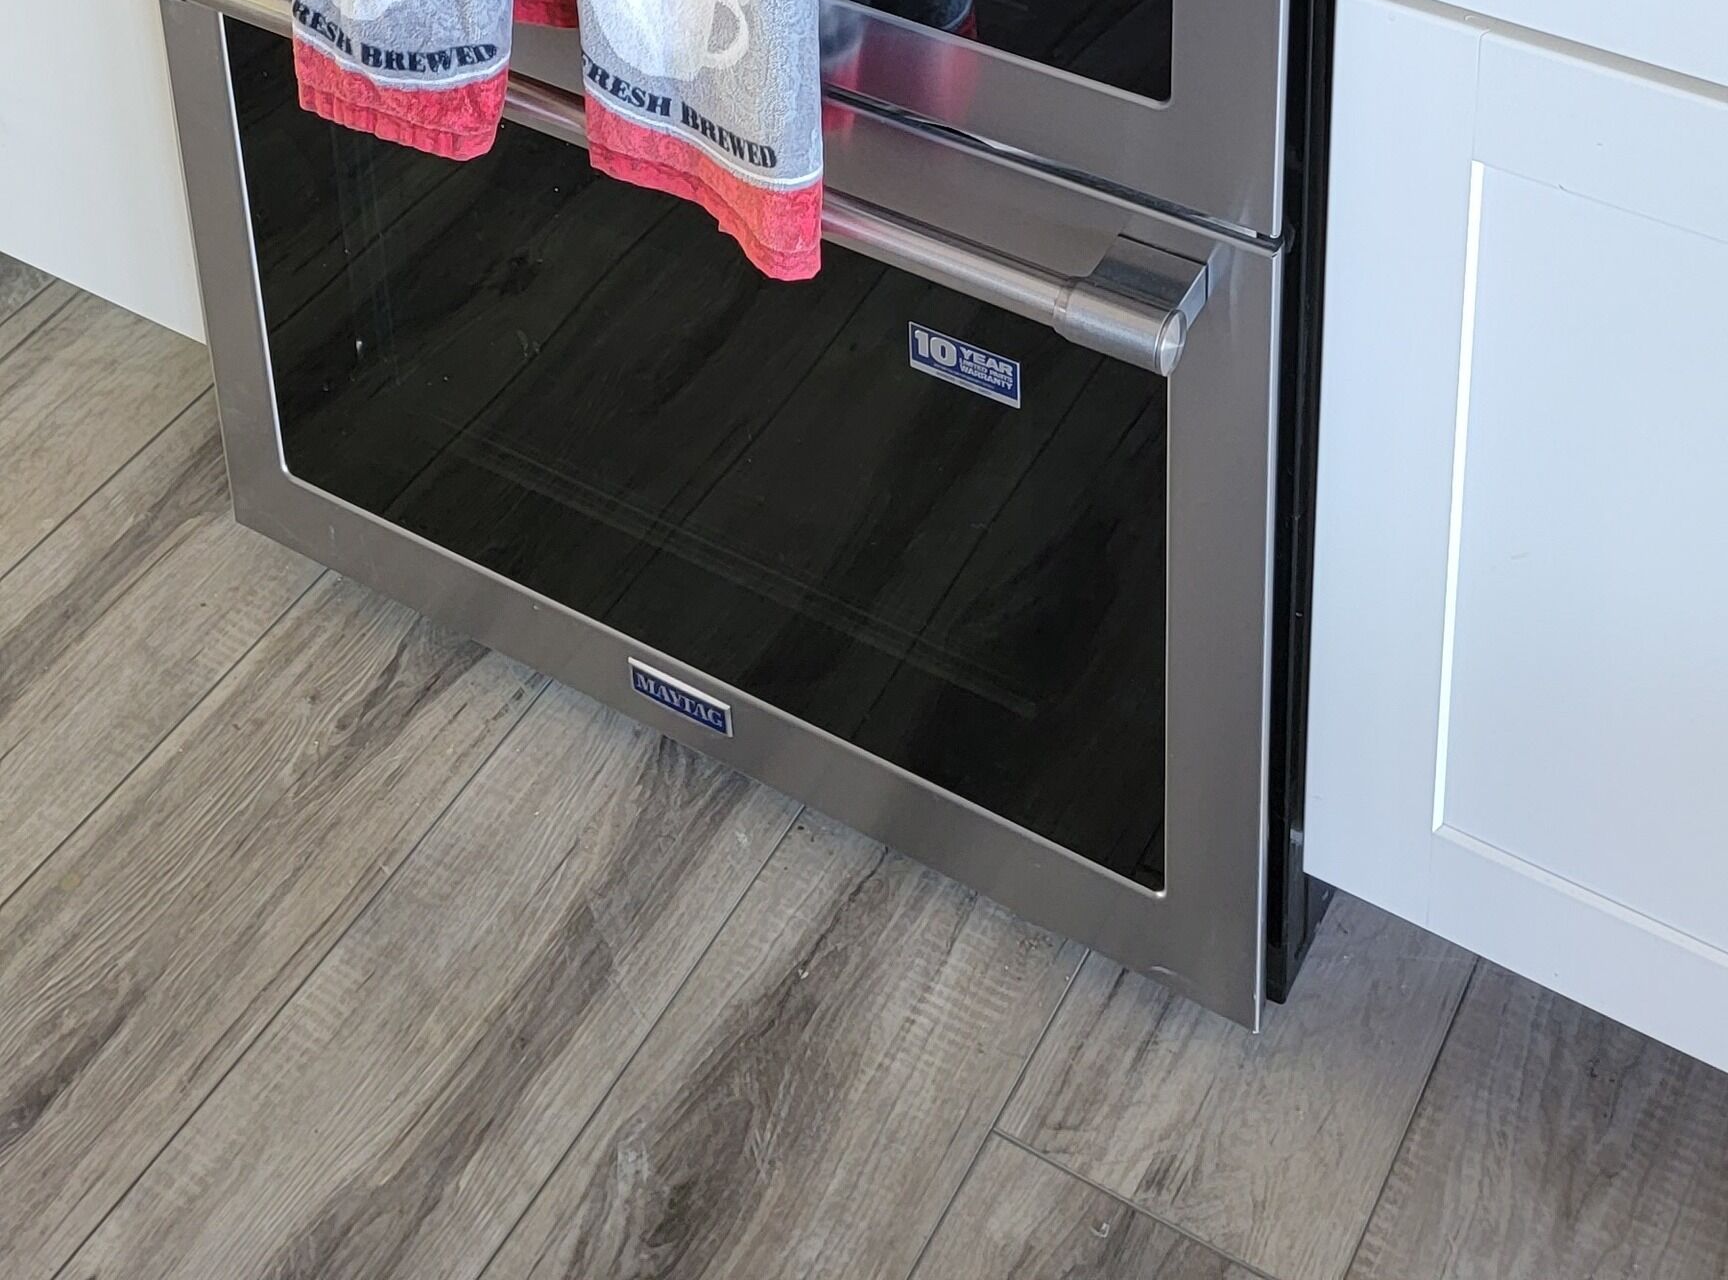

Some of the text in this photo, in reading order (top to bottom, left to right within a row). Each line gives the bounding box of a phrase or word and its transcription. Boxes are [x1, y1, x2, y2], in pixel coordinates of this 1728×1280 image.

[360, 42, 498, 73] BREWED
[680, 100, 778, 170] BREWED
[914, 329, 957, 367] 10
[959, 346, 1013, 376] YEAR
[635, 672, 724, 728] MAYTAG
